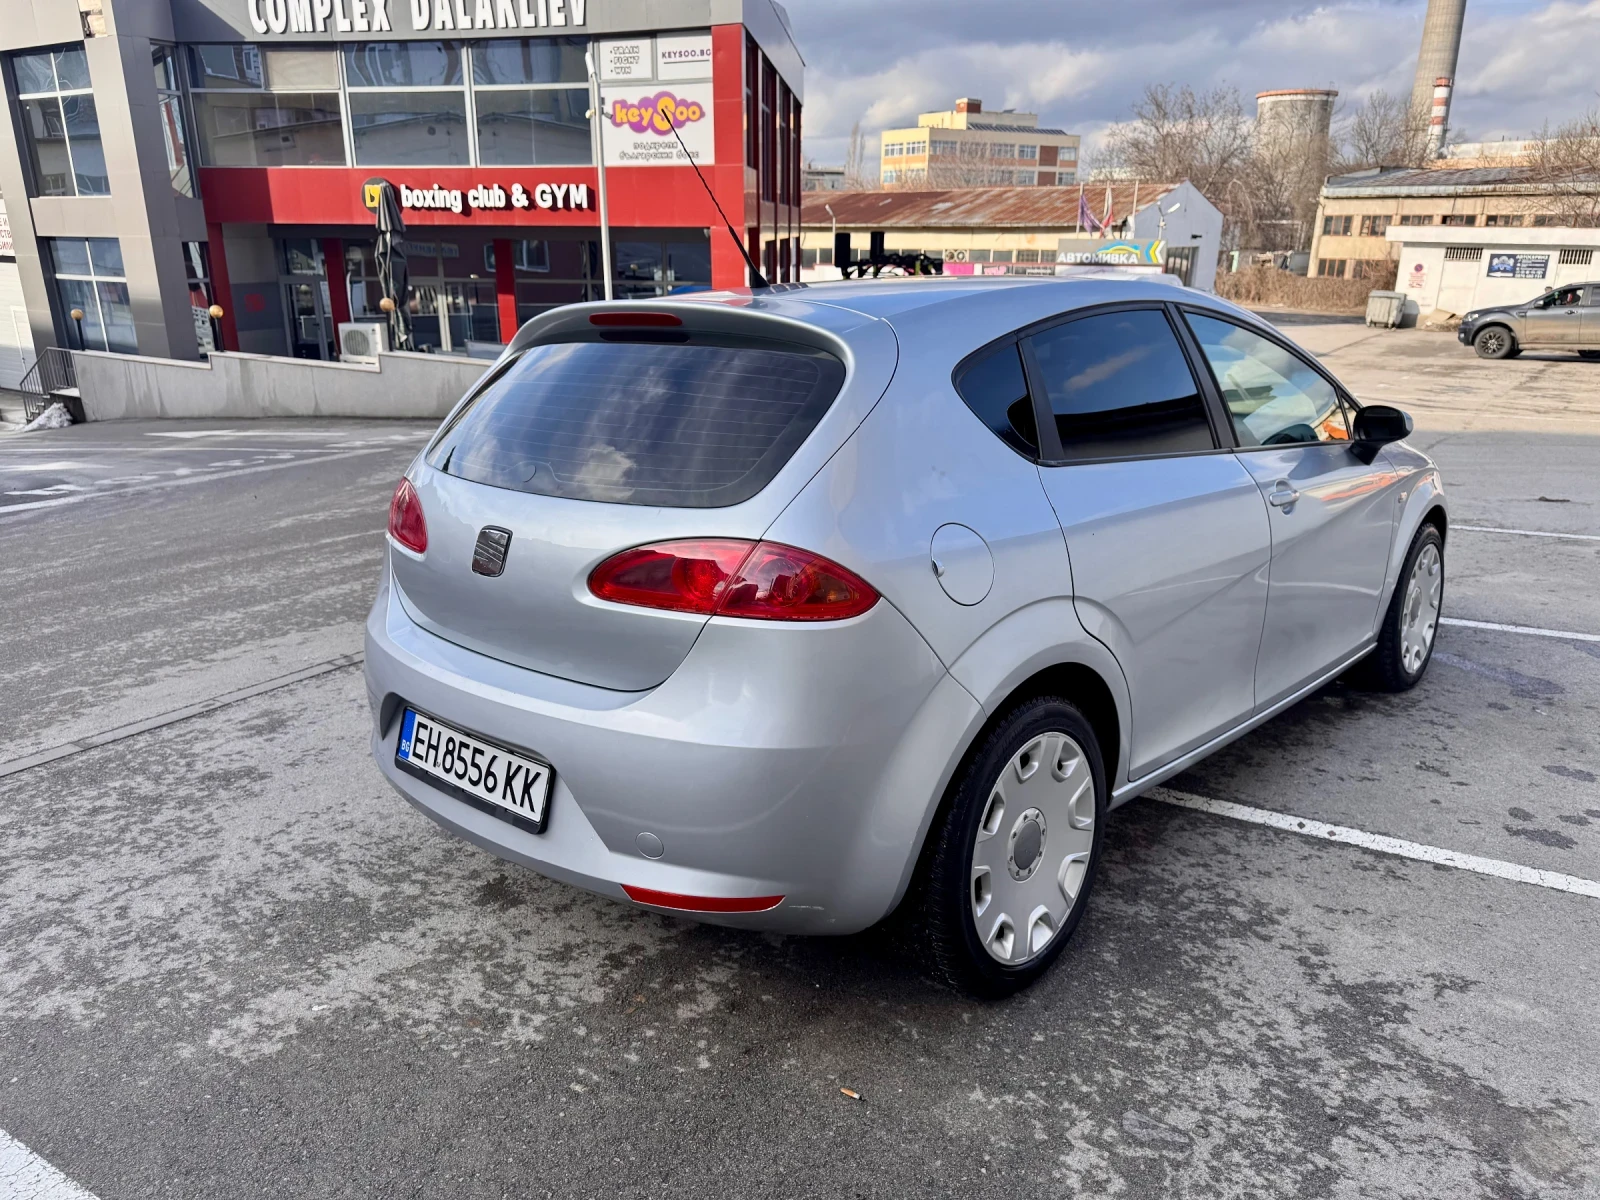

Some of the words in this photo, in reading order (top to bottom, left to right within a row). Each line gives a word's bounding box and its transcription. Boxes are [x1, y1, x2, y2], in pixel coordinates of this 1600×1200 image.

[248, 0, 392, 34] COMPLEX
[410, 0, 587, 30] DALAKLIEV
[612, 45, 640, 54] TRAIN
[661, 48, 712, 59] KEYSOO.BG
[613, 56, 640, 65] FIGHT
[613, 66, 632, 75] WIN
[400, 183, 463, 213] boxing
[467, 183, 506, 208] club
[511, 183, 529, 208] &
[534, 183, 588, 209] GYM
[1056, 251, 1139, 264] АВТОМИВКА
[401, 739, 411, 752] BG
